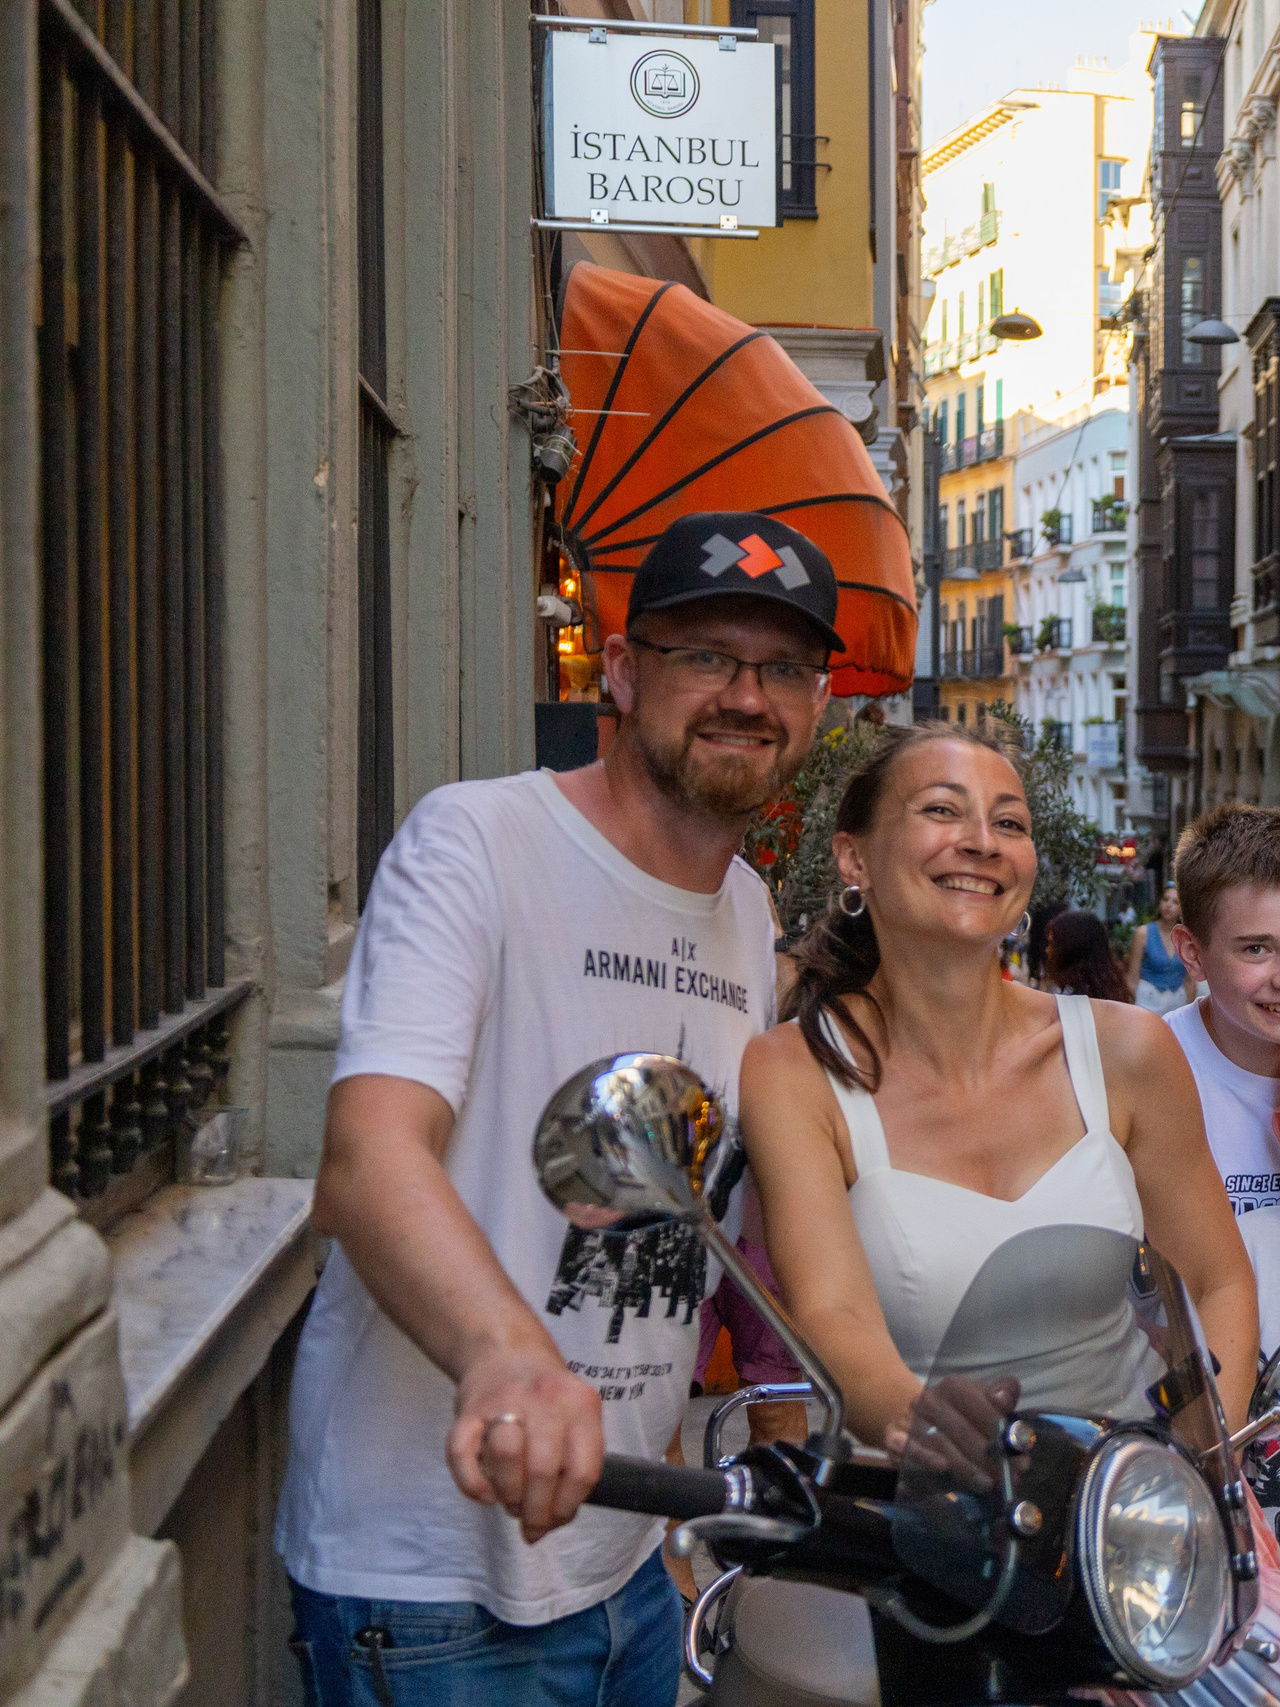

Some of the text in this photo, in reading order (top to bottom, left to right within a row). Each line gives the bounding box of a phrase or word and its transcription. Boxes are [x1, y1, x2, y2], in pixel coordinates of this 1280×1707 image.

[570, 124, 760, 168] İSTANBUL
[587, 172, 744, 207] BAROSU
[583, 949, 749, 1014] ARMANI EXCHANGE
[1226, 1174, 1270, 1193] SINCE
[599, 1385, 628, 1400] NEW
